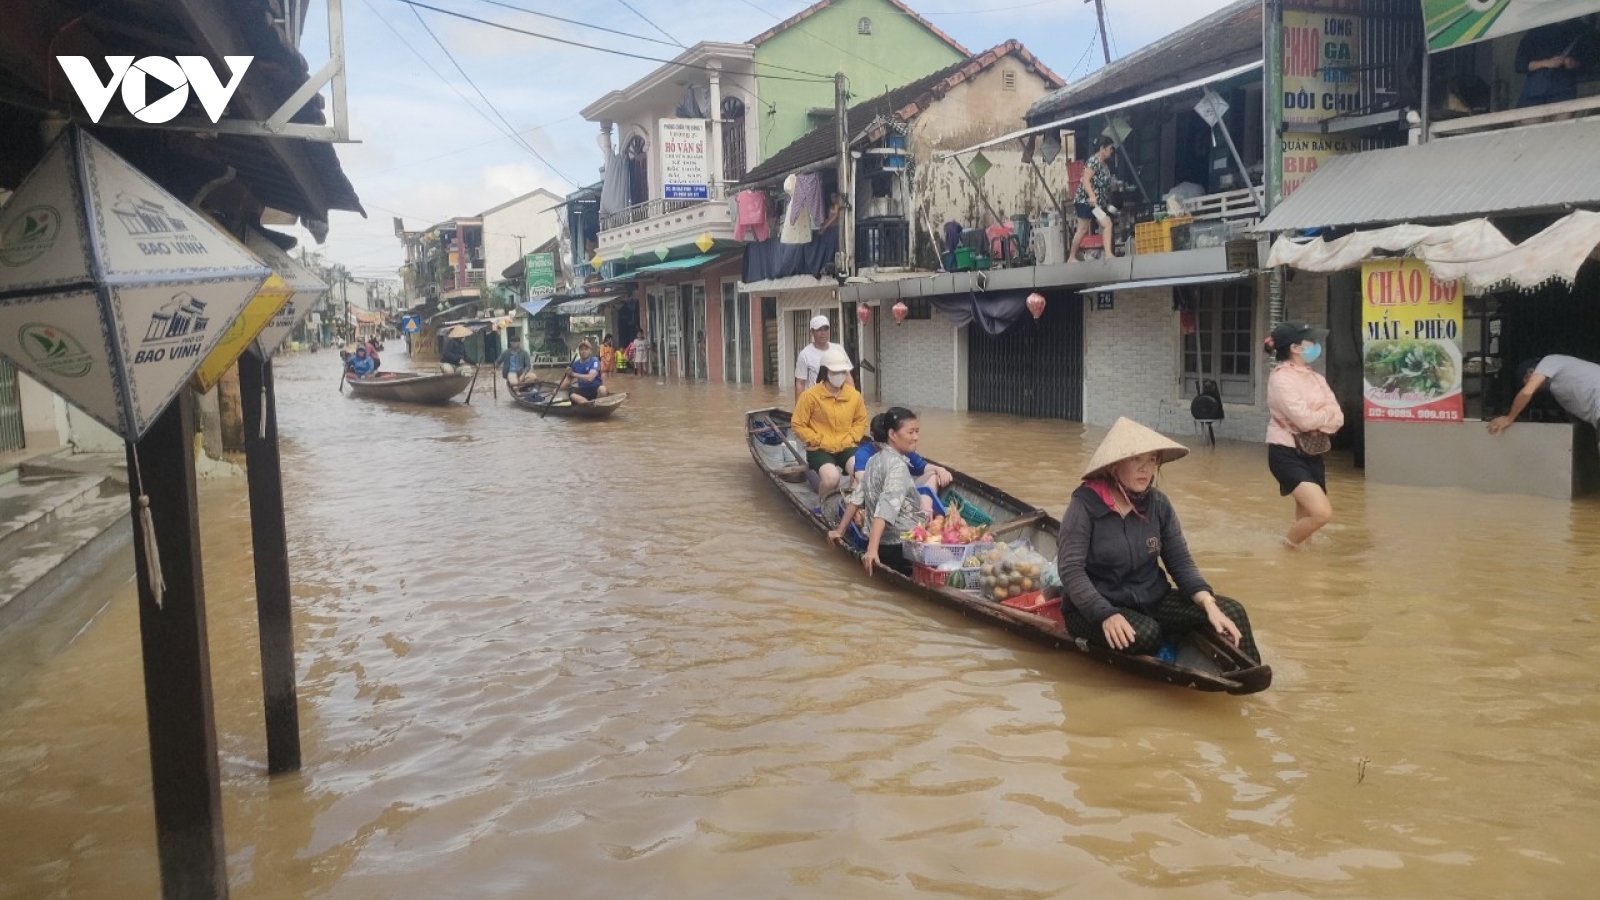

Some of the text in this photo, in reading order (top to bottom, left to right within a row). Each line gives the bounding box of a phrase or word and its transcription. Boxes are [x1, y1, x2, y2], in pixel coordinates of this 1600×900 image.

[1284, 156, 1318, 172] BIA
[138, 242, 208, 256] BAO VINH
[1367, 260, 1423, 306] CHÁO
[1414, 313, 1457, 340] PHÈO
[134, 343, 202, 364] BAO VINH
